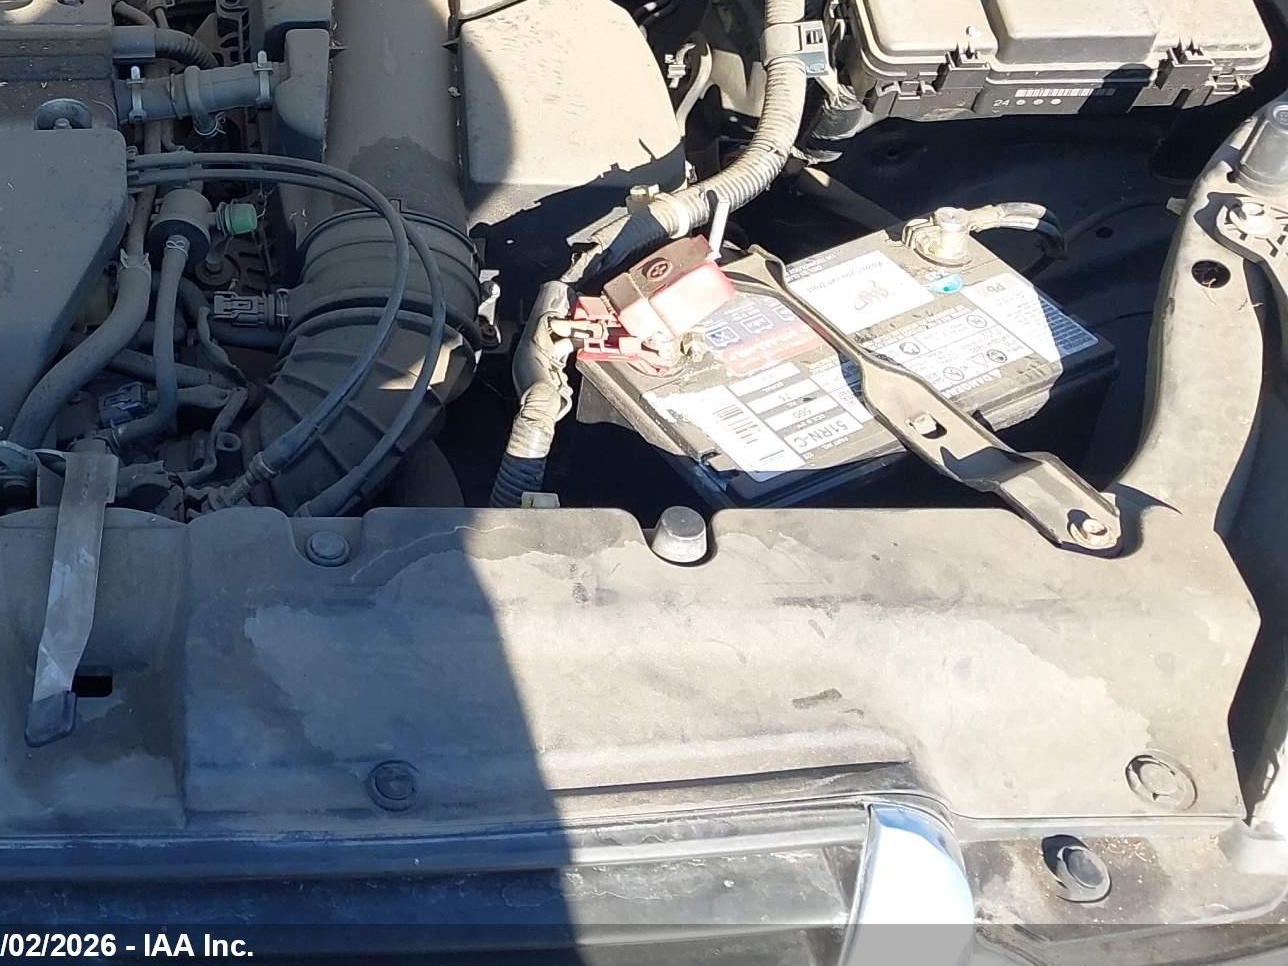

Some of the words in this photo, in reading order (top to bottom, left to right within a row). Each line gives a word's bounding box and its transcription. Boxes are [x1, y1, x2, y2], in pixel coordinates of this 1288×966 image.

[986, 282, 1006, 293] Pb
[793, 408, 812, 419] 500
[793, 420, 848, 448] 51RN-C
